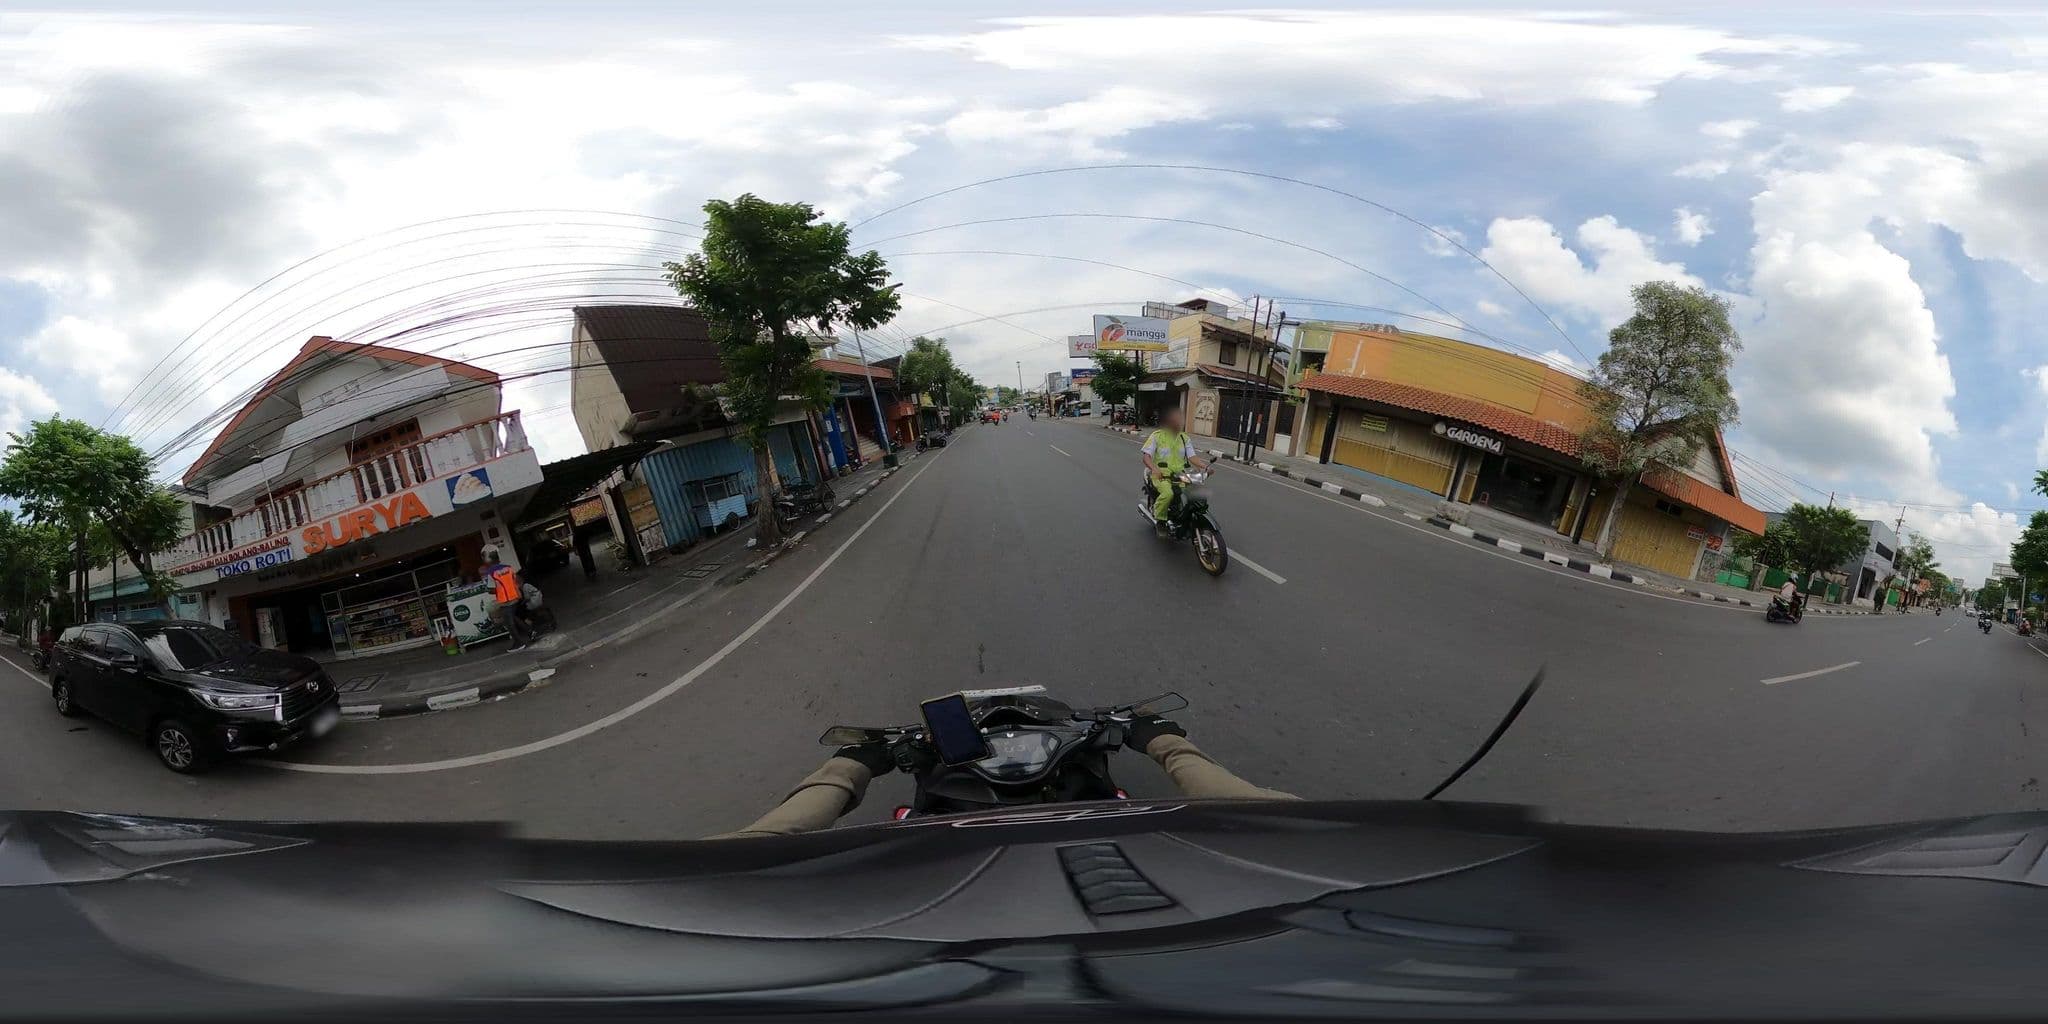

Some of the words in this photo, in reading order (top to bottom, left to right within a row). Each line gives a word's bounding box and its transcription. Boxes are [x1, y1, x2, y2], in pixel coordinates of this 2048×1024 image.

[1126, 328, 1165, 340] mangga
[1446, 426, 1502, 453] GARDENA
[301, 491, 434, 555] SURYA
[215, 560, 251, 578] TOKO
[255, 548, 291, 569] ROTI
